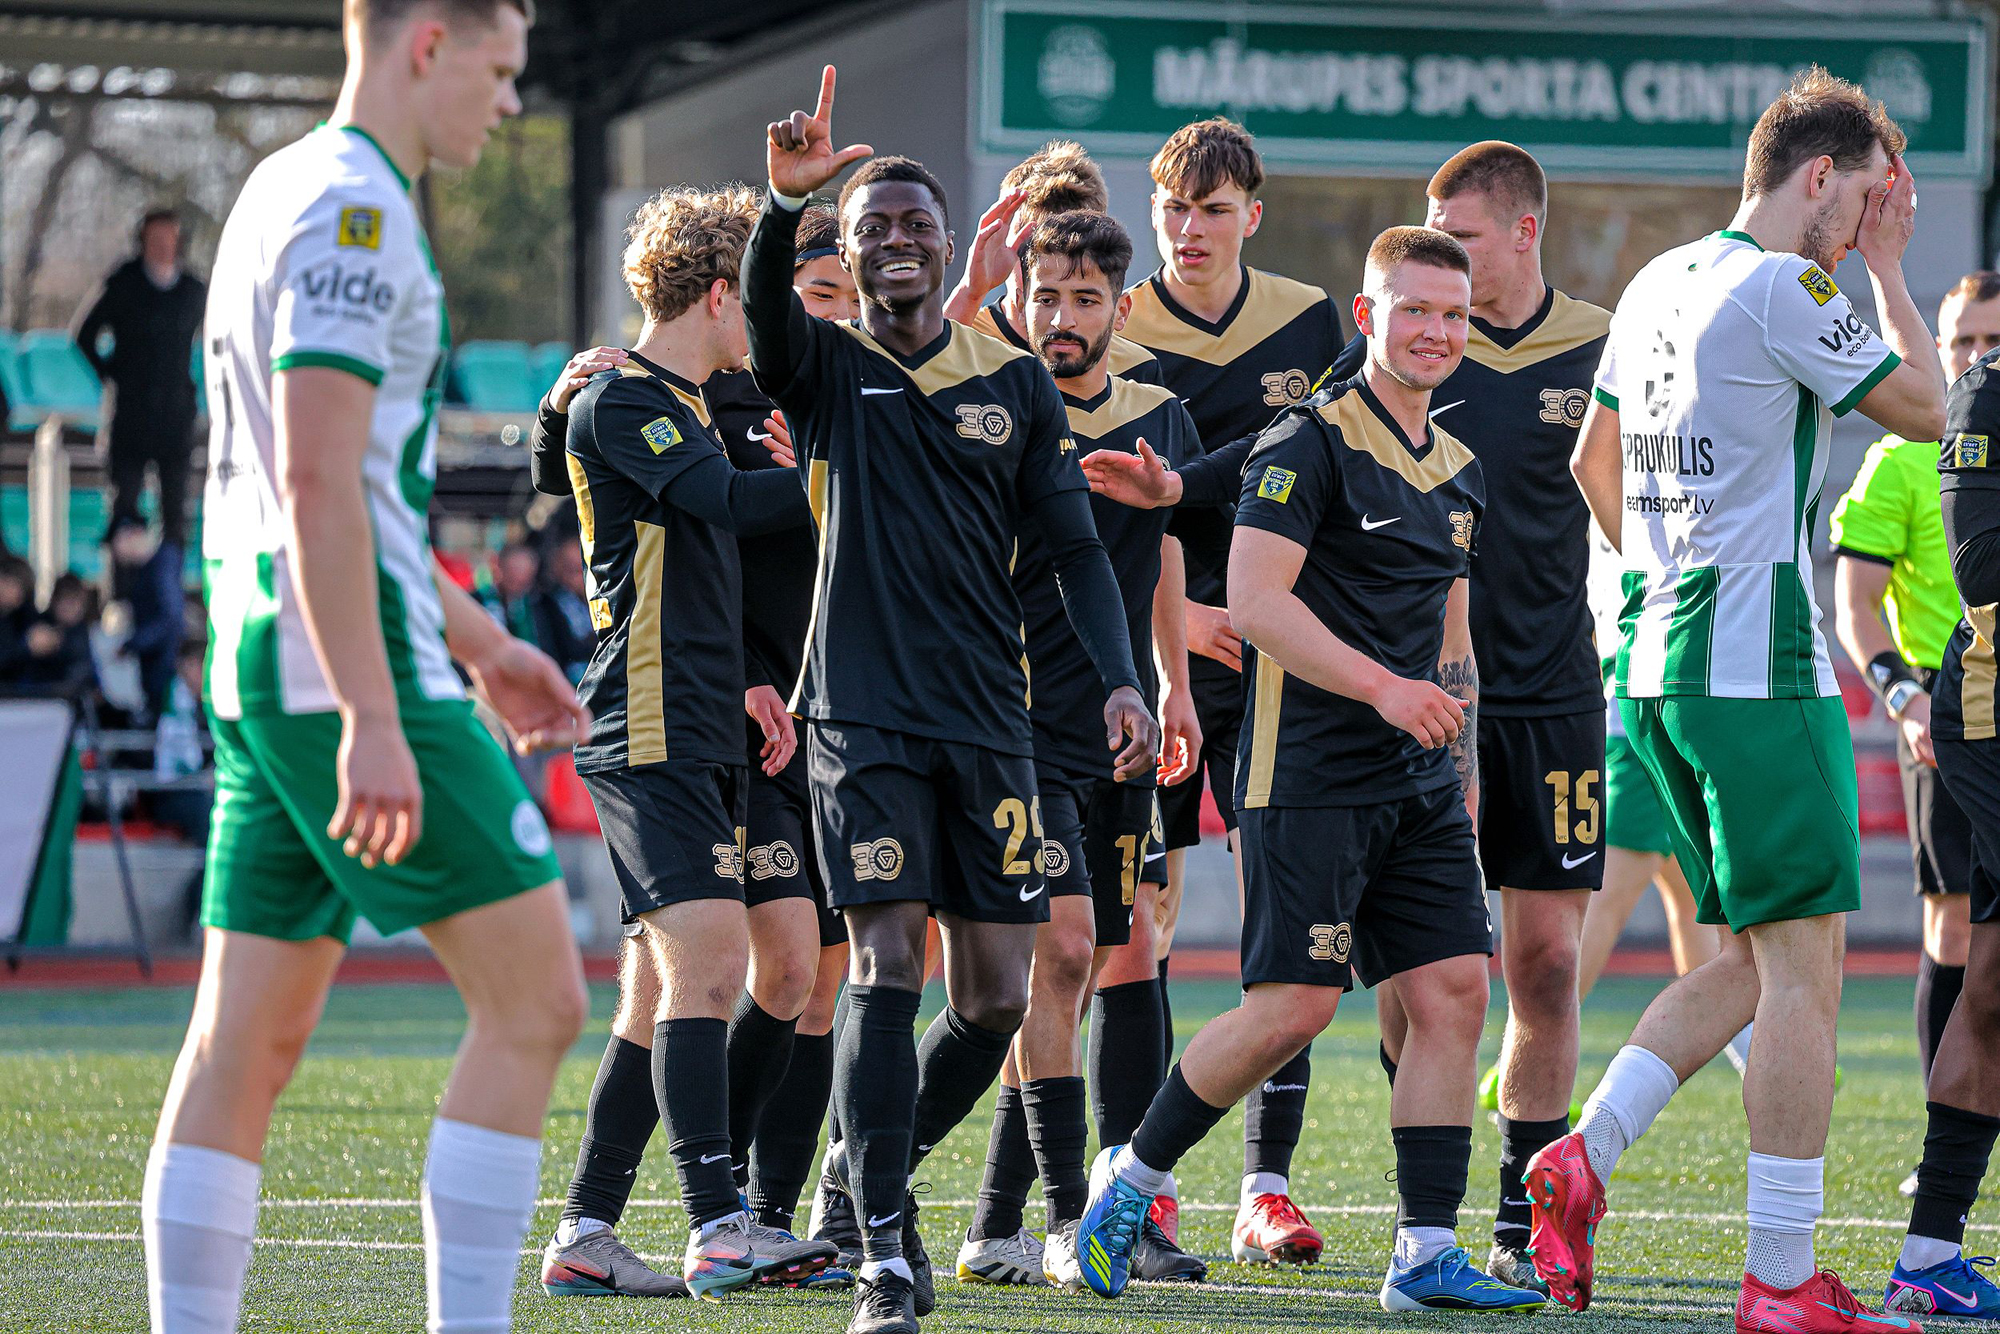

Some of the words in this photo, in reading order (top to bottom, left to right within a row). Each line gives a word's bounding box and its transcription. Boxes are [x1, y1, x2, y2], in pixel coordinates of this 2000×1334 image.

[1409, 54, 1621, 123] SPORTA
[1622, 59, 1806, 125] CENT
[302, 263, 395, 314] vide
[1818, 303, 1863, 352] vid
[1847, 333, 1862, 357] eco
[1545, 770, 1599, 844] 15
